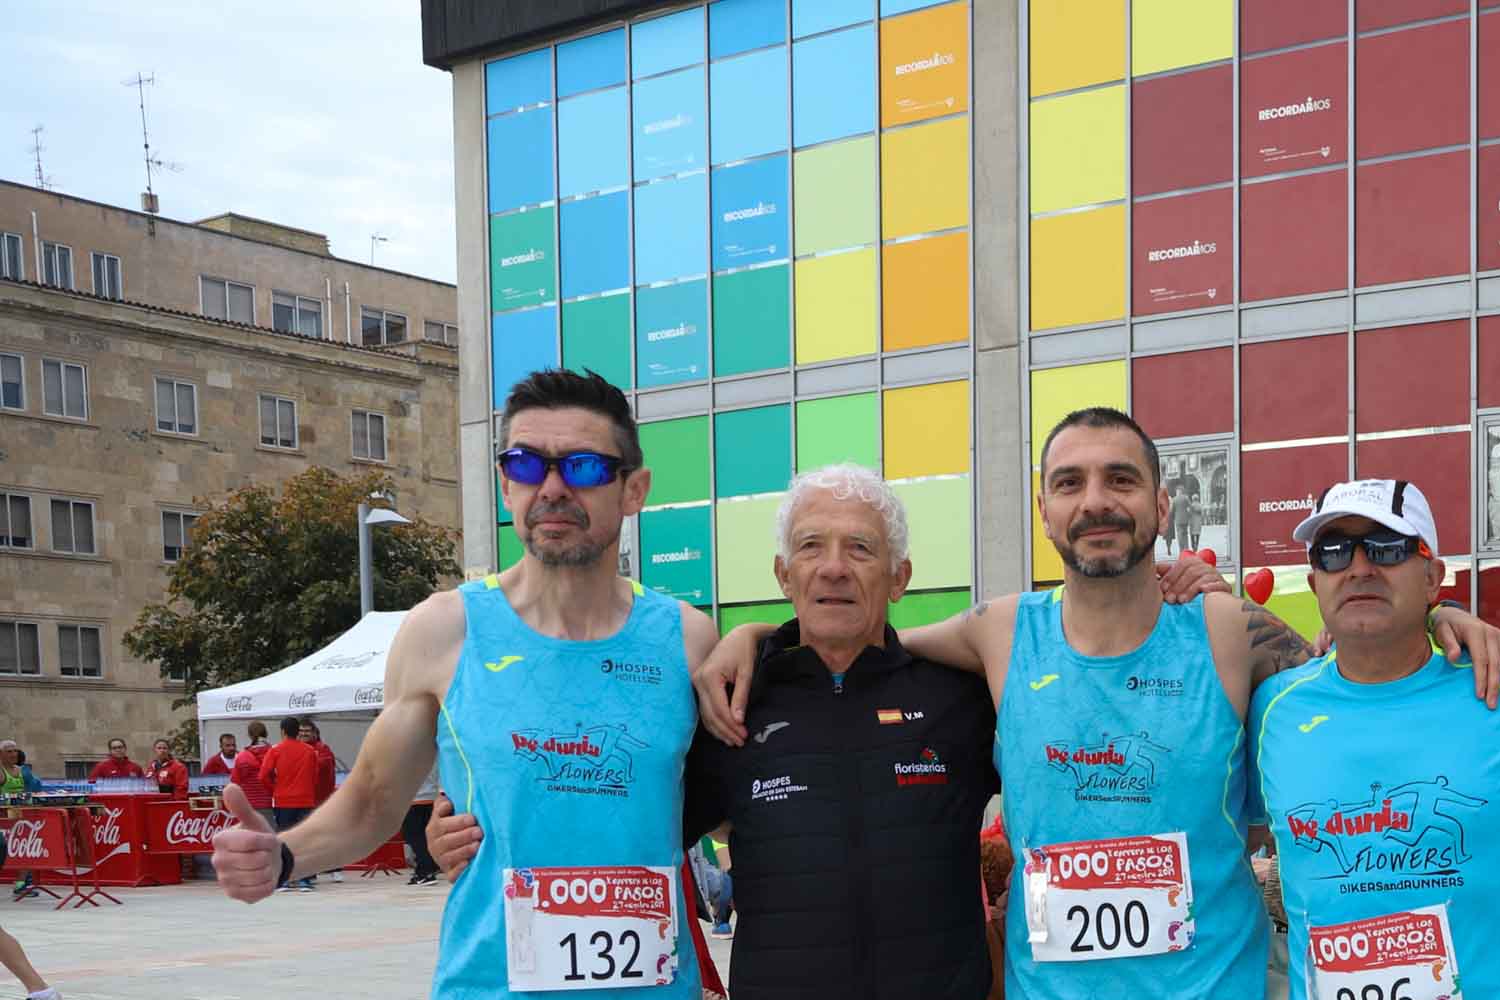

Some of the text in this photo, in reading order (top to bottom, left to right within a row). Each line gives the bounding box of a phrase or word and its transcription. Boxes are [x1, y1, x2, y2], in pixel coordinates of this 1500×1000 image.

[616, 663, 662, 676] HOSPES
[1140, 679, 1183, 689] HOSPES
[559, 762, 625, 784] FLOWERS
[1086, 772, 1146, 791] FLOWERS
[762, 776, 791, 790] HOSPES
[1116, 854, 1174, 872] PASOS
[1353, 845, 1452, 873] FLOWERS
[614, 886, 664, 900] PASOS
[1066, 900, 1149, 952] 200
[1376, 928, 1435, 951] PASOS
[559, 930, 643, 981] 132
